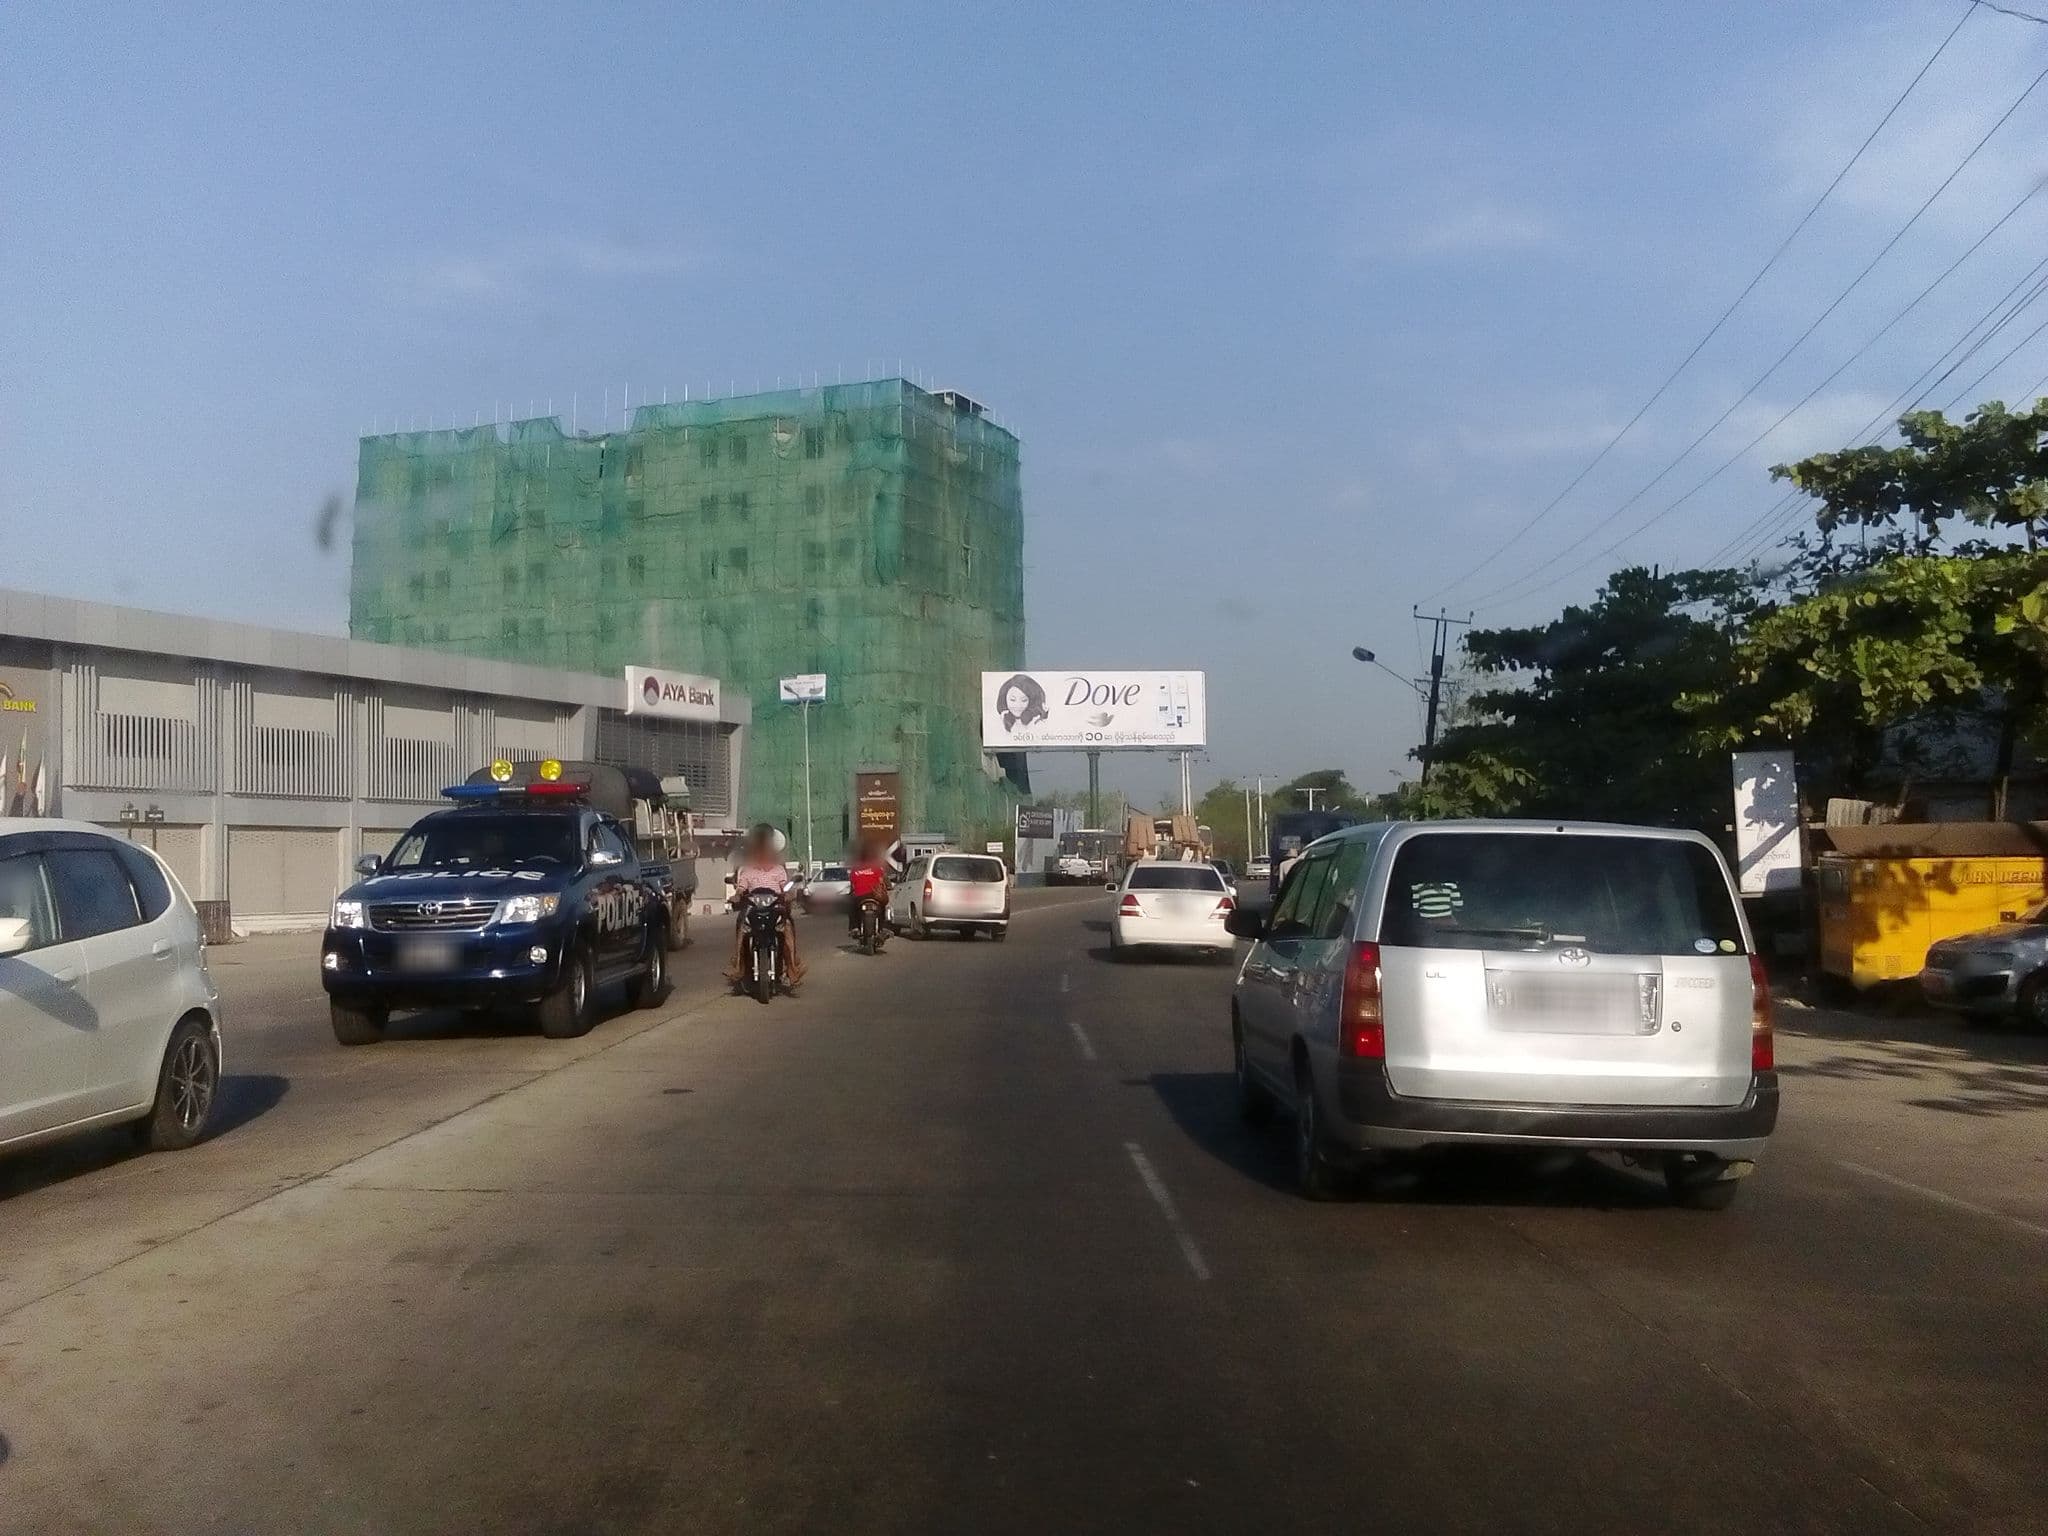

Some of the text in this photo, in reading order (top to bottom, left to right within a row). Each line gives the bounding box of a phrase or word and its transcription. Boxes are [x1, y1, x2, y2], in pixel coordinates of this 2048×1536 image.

[662, 682, 714, 706] AYA Bank
[1063, 676, 1141, 706] Dove
[3, 700, 36, 712] BANK
[598, 884, 643, 933] POLICE
